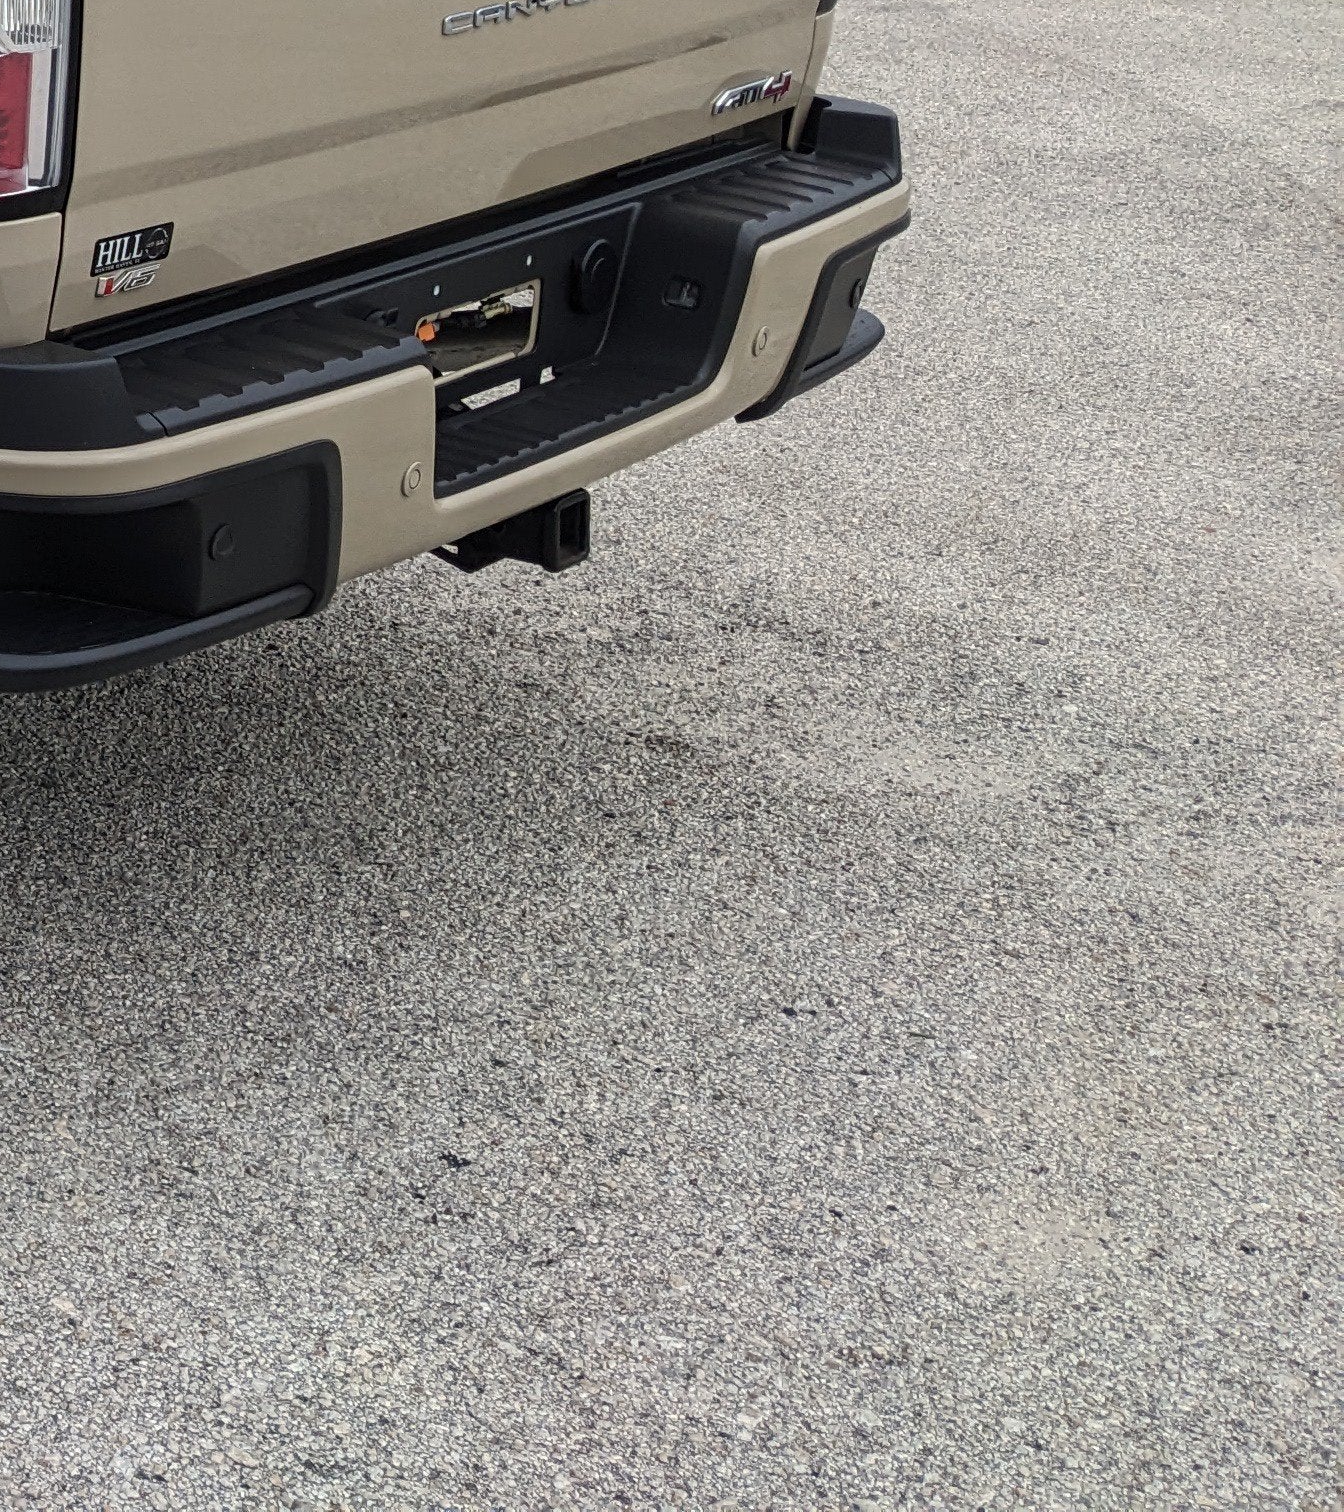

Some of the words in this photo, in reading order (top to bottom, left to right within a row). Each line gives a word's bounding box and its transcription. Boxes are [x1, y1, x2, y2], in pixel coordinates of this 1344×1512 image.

[710, 70, 793, 116] AT4
[96, 233, 143, 268] HILL
[95, 264, 161, 297] V6
